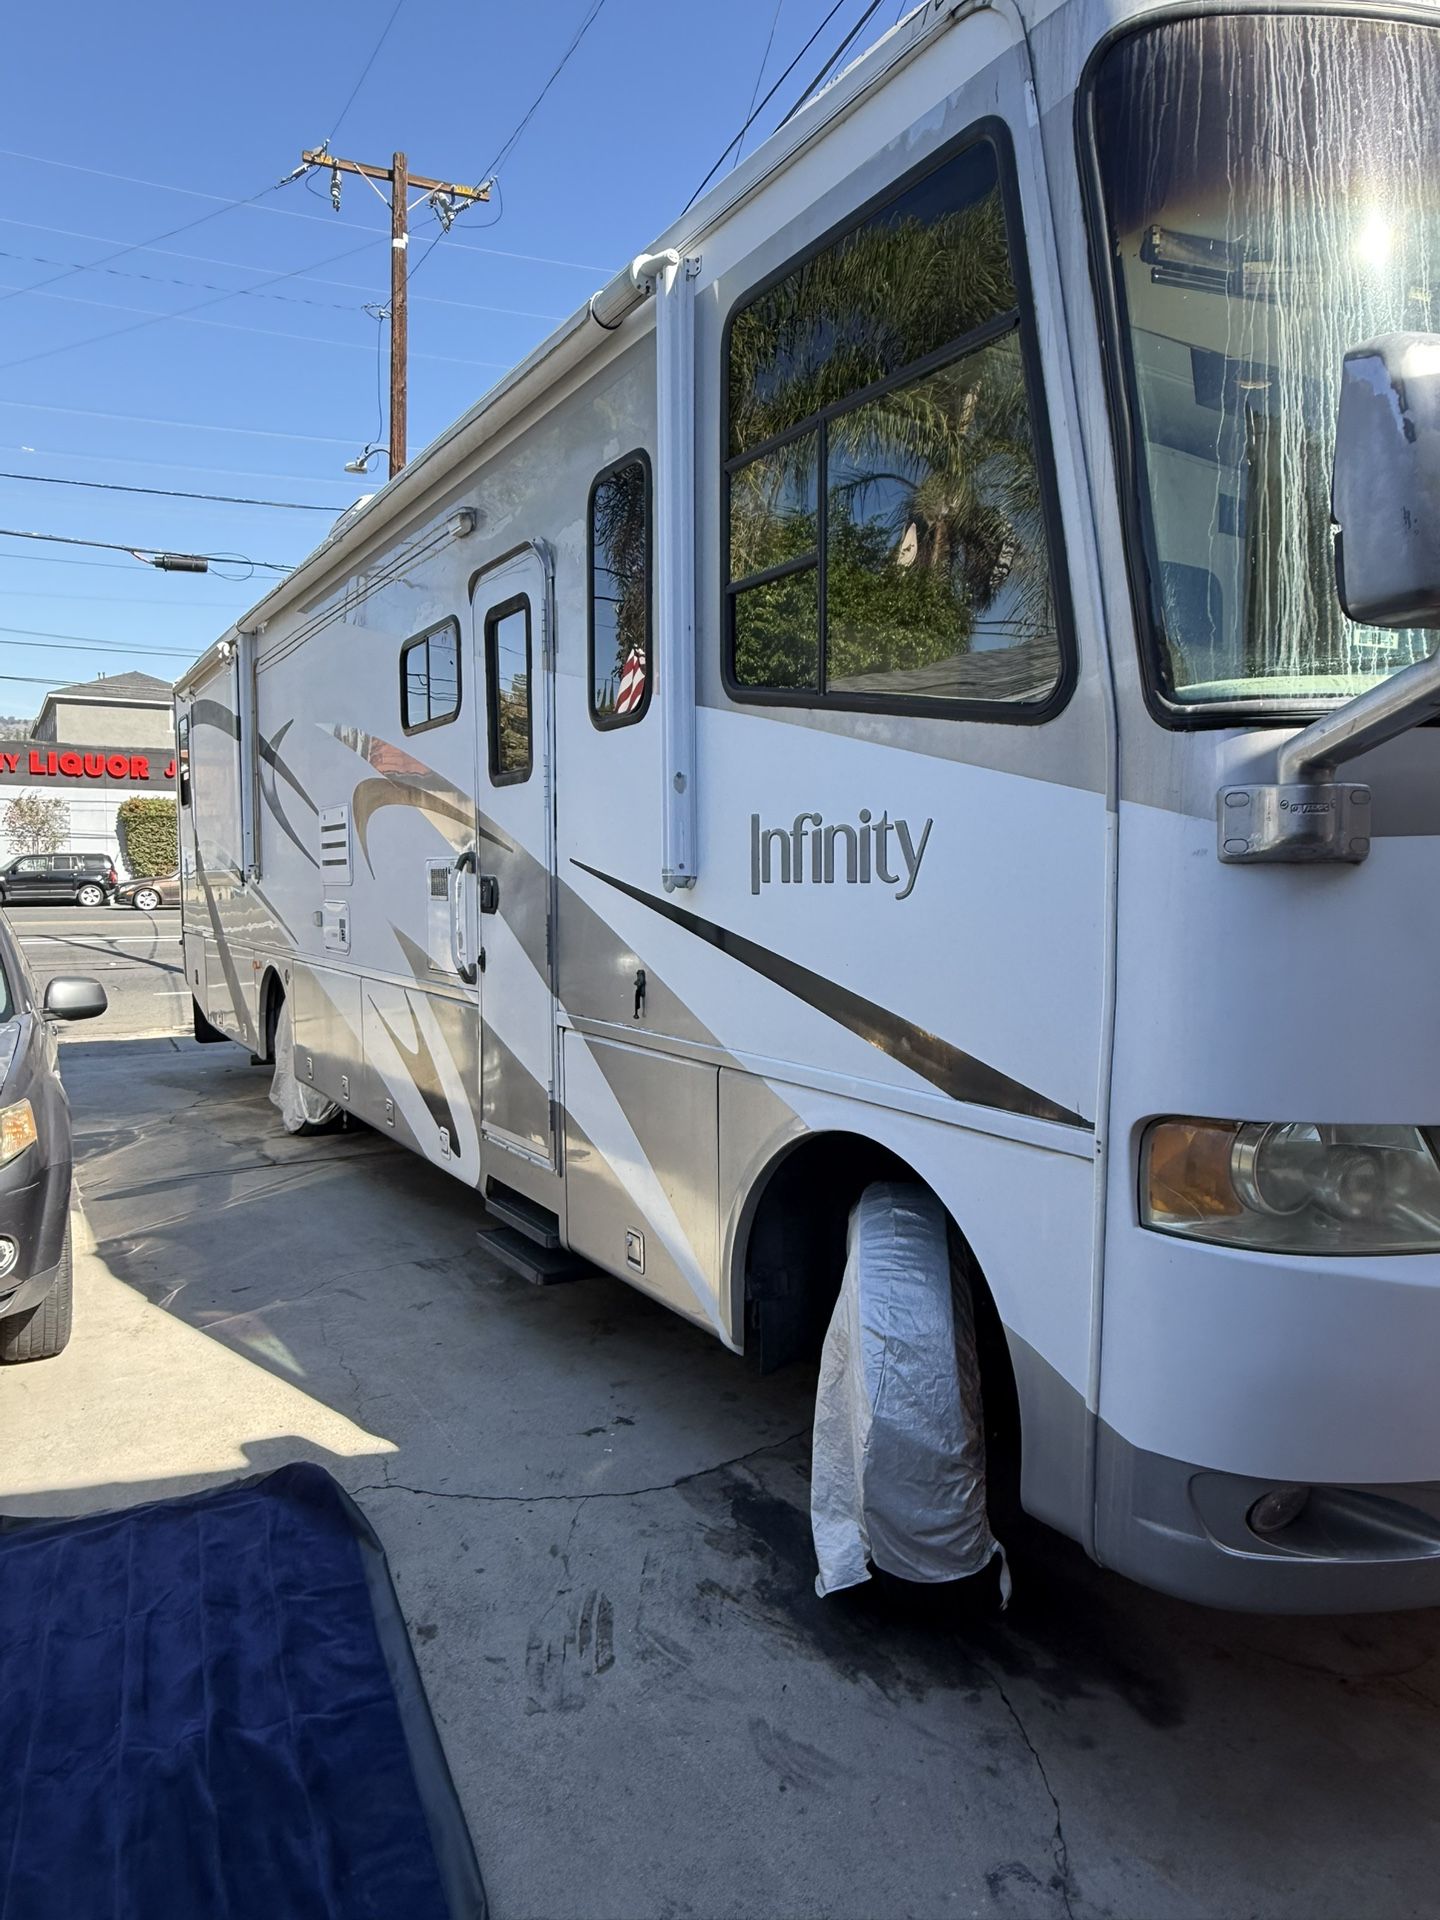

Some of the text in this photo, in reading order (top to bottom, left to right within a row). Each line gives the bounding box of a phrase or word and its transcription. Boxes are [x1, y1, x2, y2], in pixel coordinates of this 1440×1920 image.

[0, 752, 20, 773] Y
[29, 750, 150, 780] LIQUOR
[751, 808, 933, 900] Infinity
